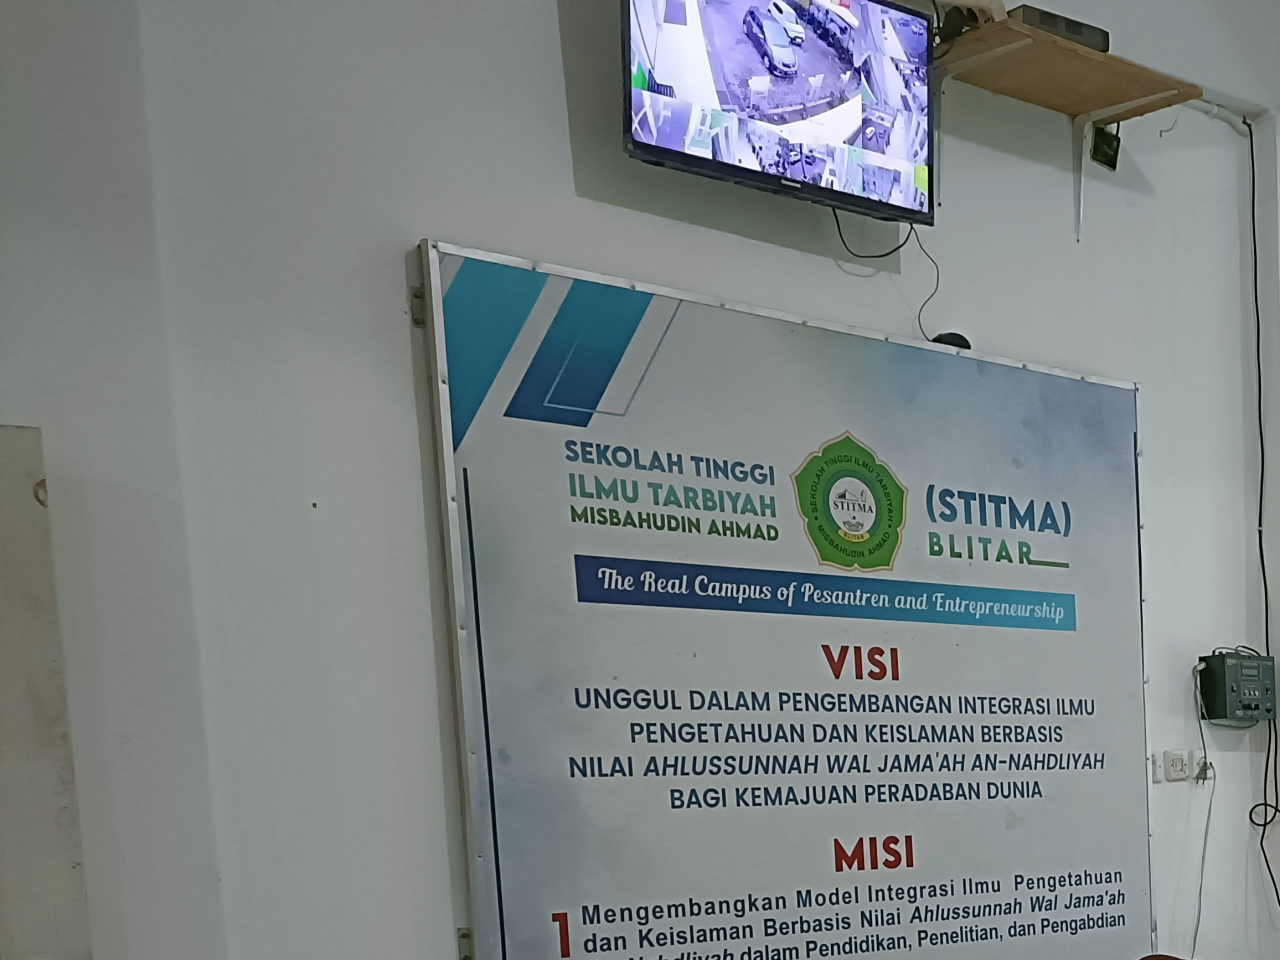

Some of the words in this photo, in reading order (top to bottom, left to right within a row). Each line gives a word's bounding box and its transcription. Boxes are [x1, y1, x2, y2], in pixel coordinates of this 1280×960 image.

[565, 440, 684, 475] SEKOLAH
[690, 455, 775, 486] TINGGI
[568, 472, 639, 503] ILMU
[647, 482, 777, 518] TARBIYAH
[809, 466, 826, 514] SEKOLAH
[824, 454, 853, 469] TINGGI
[854, 456, 874, 474] ILMU
[875, 472, 894, 522] TARBIYAH
[570, 505, 701, 534] MISBAHUDIN
[707, 519, 779, 542] AHMAD
[833, 500, 874, 514] STITMA
[926, 484, 1072, 538] (STITMA)
[817, 524, 865, 558] MISBAHUDIN
[868, 531, 890, 556] AHMAD
[928, 531, 1032, 565] BLITAR
[598, 567, 635, 591] The
[640, 571, 689, 594] Real
[694, 575, 772, 604] Campus
[777, 582, 798, 607] of
[801, 583, 891, 608] Pesantren
[894, 592, 928, 610] and
[932, 592, 1064, 624] Entrepreneurship
[820, 644, 900, 681] VISI
[574, 688, 682, 710] UNGGUL
[689, 690, 771, 711] DALAM
[778, 692, 952, 713] PENGEMBANGAN
[958, 696, 1050, 715] INTEGRASI
[1056, 699, 1095, 716] ILMU
[630, 722, 805, 743] PENGETAHUAN
[812, 724, 858, 743] DAN
[865, 724, 975, 743] KEISLAMAN
[980, 725, 1063, 743] BERBASIS
[569, 756, 634, 778] NILAI
[643, 755, 819, 777] AHLUSSUNNAH
[826, 754, 871, 774] WAL
[877, 752, 966, 773] JAMA'AH
[970, 753, 1105, 772] AN-NAHDLIYAH
[670, 788, 727, 809] BAGI
[735, 785, 857, 807] KEMAJUAN
[864, 782, 981, 804] PERADABAN
[986, 781, 1043, 800] DUNIA
[834, 835, 914, 872] MISI
[581, 894, 787, 925] Mengembangkan
[796, 886, 859, 908] Model
[867, 879, 955, 903] Integrasi
[962, 878, 1001, 896] Ilmu
[1014, 870, 1123, 892] Pengetahuan
[552, 912, 571, 958] 1
[583, 934, 627, 953] dan
[638, 924, 754, 949] Keislaman
[763, 913, 851, 937] Berbasis
[860, 909, 901, 928] Nilai
[909, 899, 1023, 924] Ahlussunnah
[1029, 895, 1058, 913] Wal
[1064, 890, 1125, 910] Jama'ah
[805, 934, 912, 959] Pendidikan,
[917, 924, 1003, 947] Penelitian,
[1007, 921, 1036, 938] dan
[1041, 912, 1126, 935] Pengabdian
